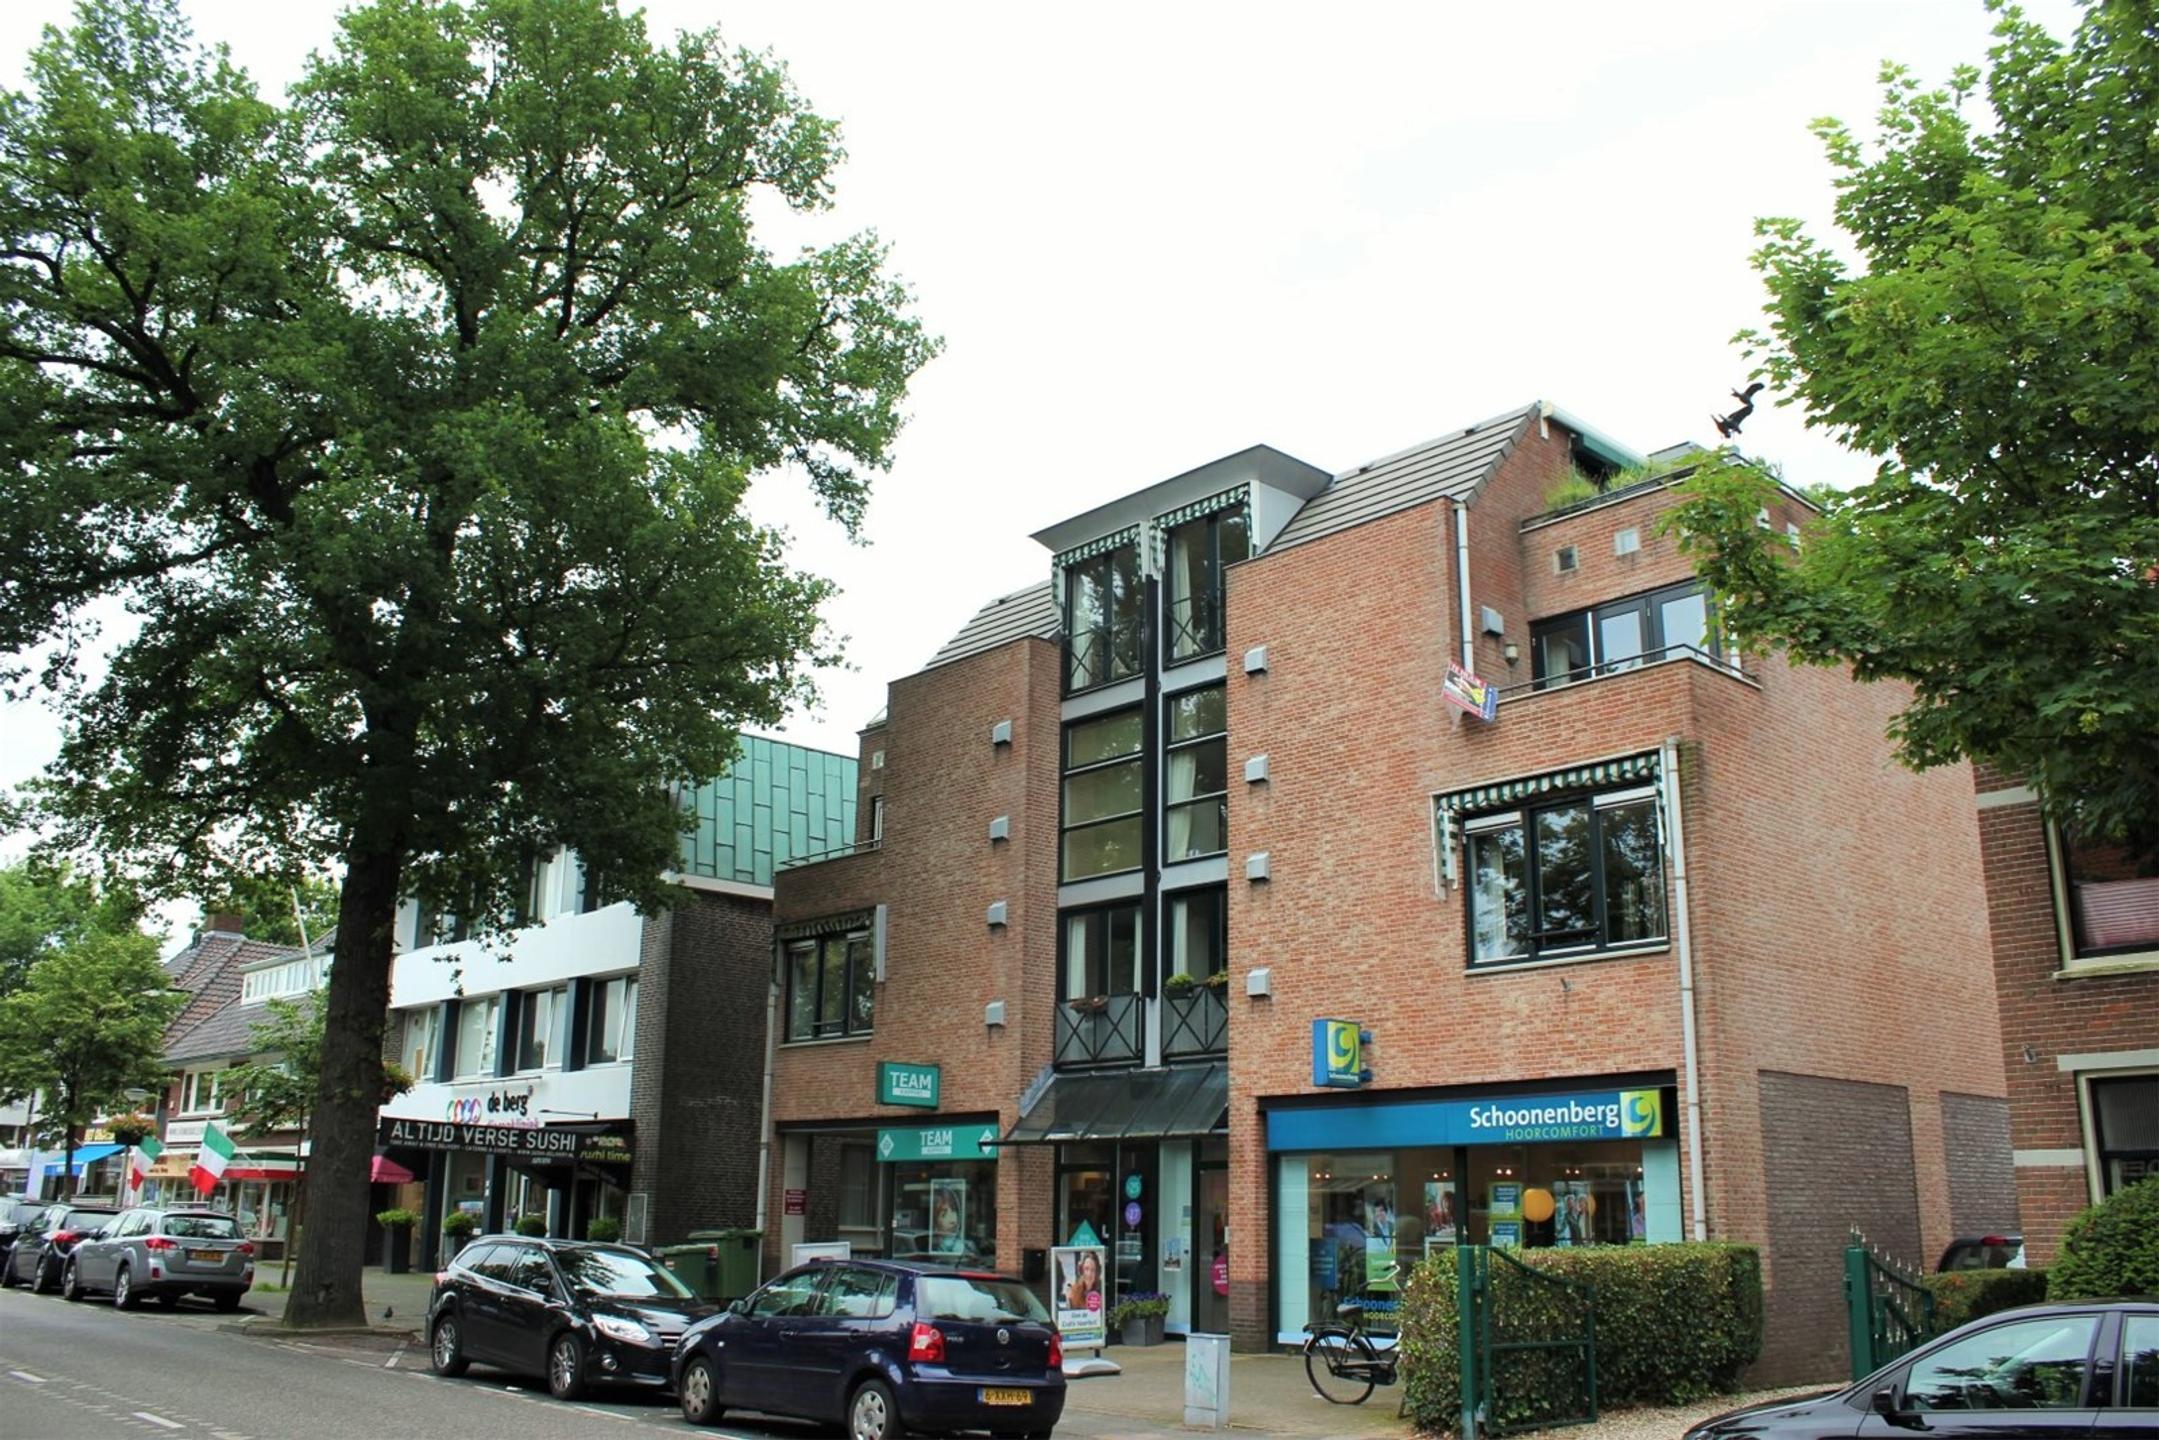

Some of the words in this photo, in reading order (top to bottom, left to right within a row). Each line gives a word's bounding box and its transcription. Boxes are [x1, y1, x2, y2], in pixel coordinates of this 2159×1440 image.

[890, 1071, 932, 1089] TEAM
[487, 1091, 500, 1113] de
[1470, 1101, 1620, 1128] Schoonenberg
[391, 1120, 455, 1143] ALTIJD
[462, 1126, 519, 1148] VERSE
[526, 1131, 576, 1151] SUSHI
[920, 1129, 952, 1146] TEAM
[1505, 1125, 1604, 1141] HOORCOMFORT
[607, 1150, 632, 1161] time
